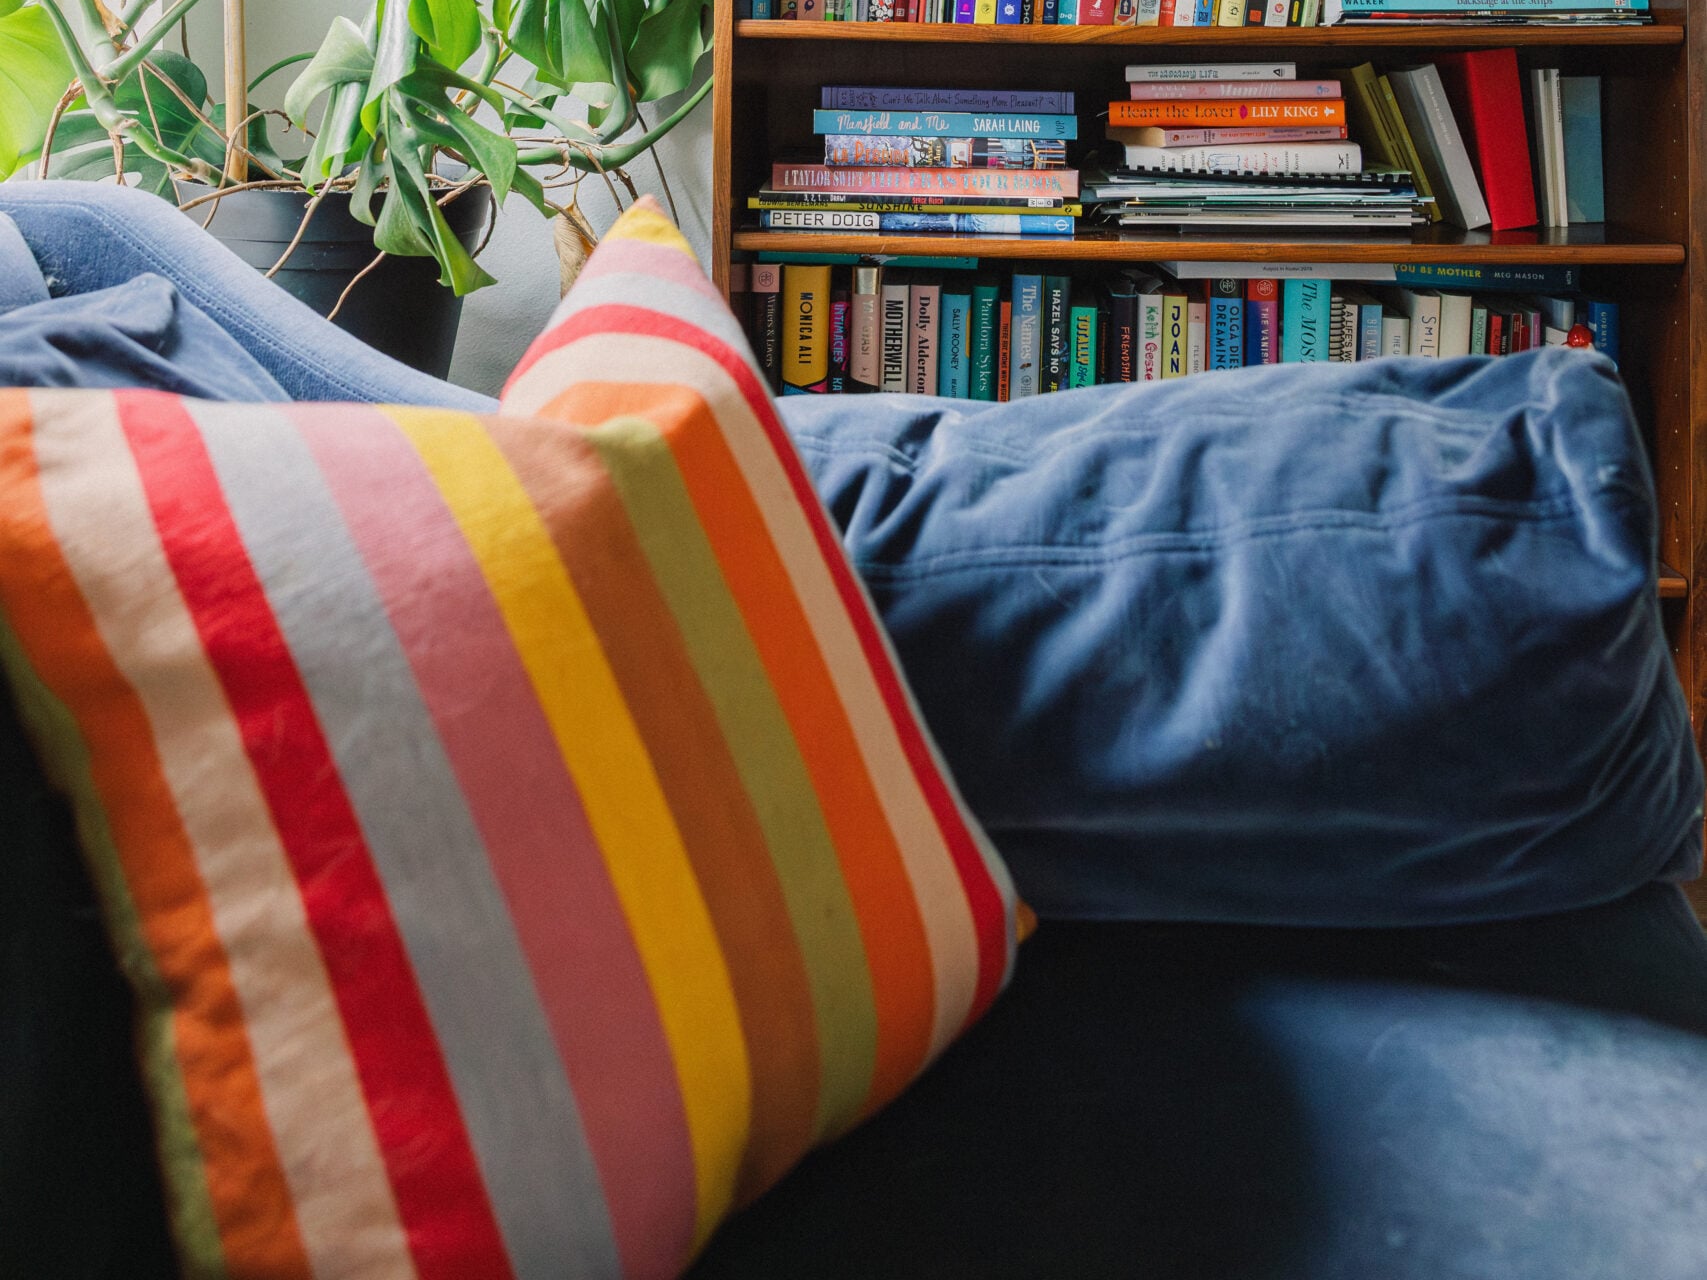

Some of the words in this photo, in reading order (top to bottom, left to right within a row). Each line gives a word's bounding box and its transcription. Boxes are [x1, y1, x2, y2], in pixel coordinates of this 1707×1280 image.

[1200, 70, 1218, 78] LIFE
[837, 114, 892, 131] Mansfield
[898, 118, 922, 131] and
[926, 116, 949, 131] Me
[973, 118, 1006, 132] SARAH
[1008, 119, 1041, 133] LAING
[1120, 105, 1161, 119] Heart
[1165, 105, 1190, 118] the
[1194, 105, 1236, 119] Lover
[1252, 106, 1279, 117] LILY
[1284, 106, 1318, 117] KING
[792, 171, 831, 186] TAYLOR
[833, 171, 863, 187] SWIFT
[960, 173, 1008, 190] TOUR
[773, 212, 824, 225] PETER
[832, 214, 873, 226] DOIG
[859, 202, 923, 211] SUNSHINE
[1420, 266, 1432, 274] BE
[1437, 268, 1481, 278] MOTHER
[1515, 272, 1545, 280] MASON
[1022, 284, 1037, 310] The
[1052, 289, 1061, 324] HAZEL
[1301, 282, 1317, 311] The
[767, 295, 777, 329] Writers
[799, 292, 813, 340] MONICA
[916, 296, 931, 331] Dolly
[952, 308, 961, 329] SALLY
[980, 298, 993, 347] Pandora
[1145, 306, 1160, 339] Keith
[1229, 306, 1239, 345] OLGA
[1261, 308, 1269, 327] THE
[832, 303, 845, 363] INTIMACIES
[883, 300, 904, 385] MOTHERWELL
[1020, 313, 1036, 361] Names
[1051, 327, 1060, 357] SAYS
[1171, 305, 1180, 373] JOAN
[1345, 320, 1353, 349] LIFE'S
[799, 346, 811, 364] ALI
[916, 336, 930, 394] Alderton
[951, 331, 960, 370] ROONEY
[1229, 347, 1239, 370] DIES
[979, 352, 992, 392] Sykes
[1050, 358, 1059, 374] NO
